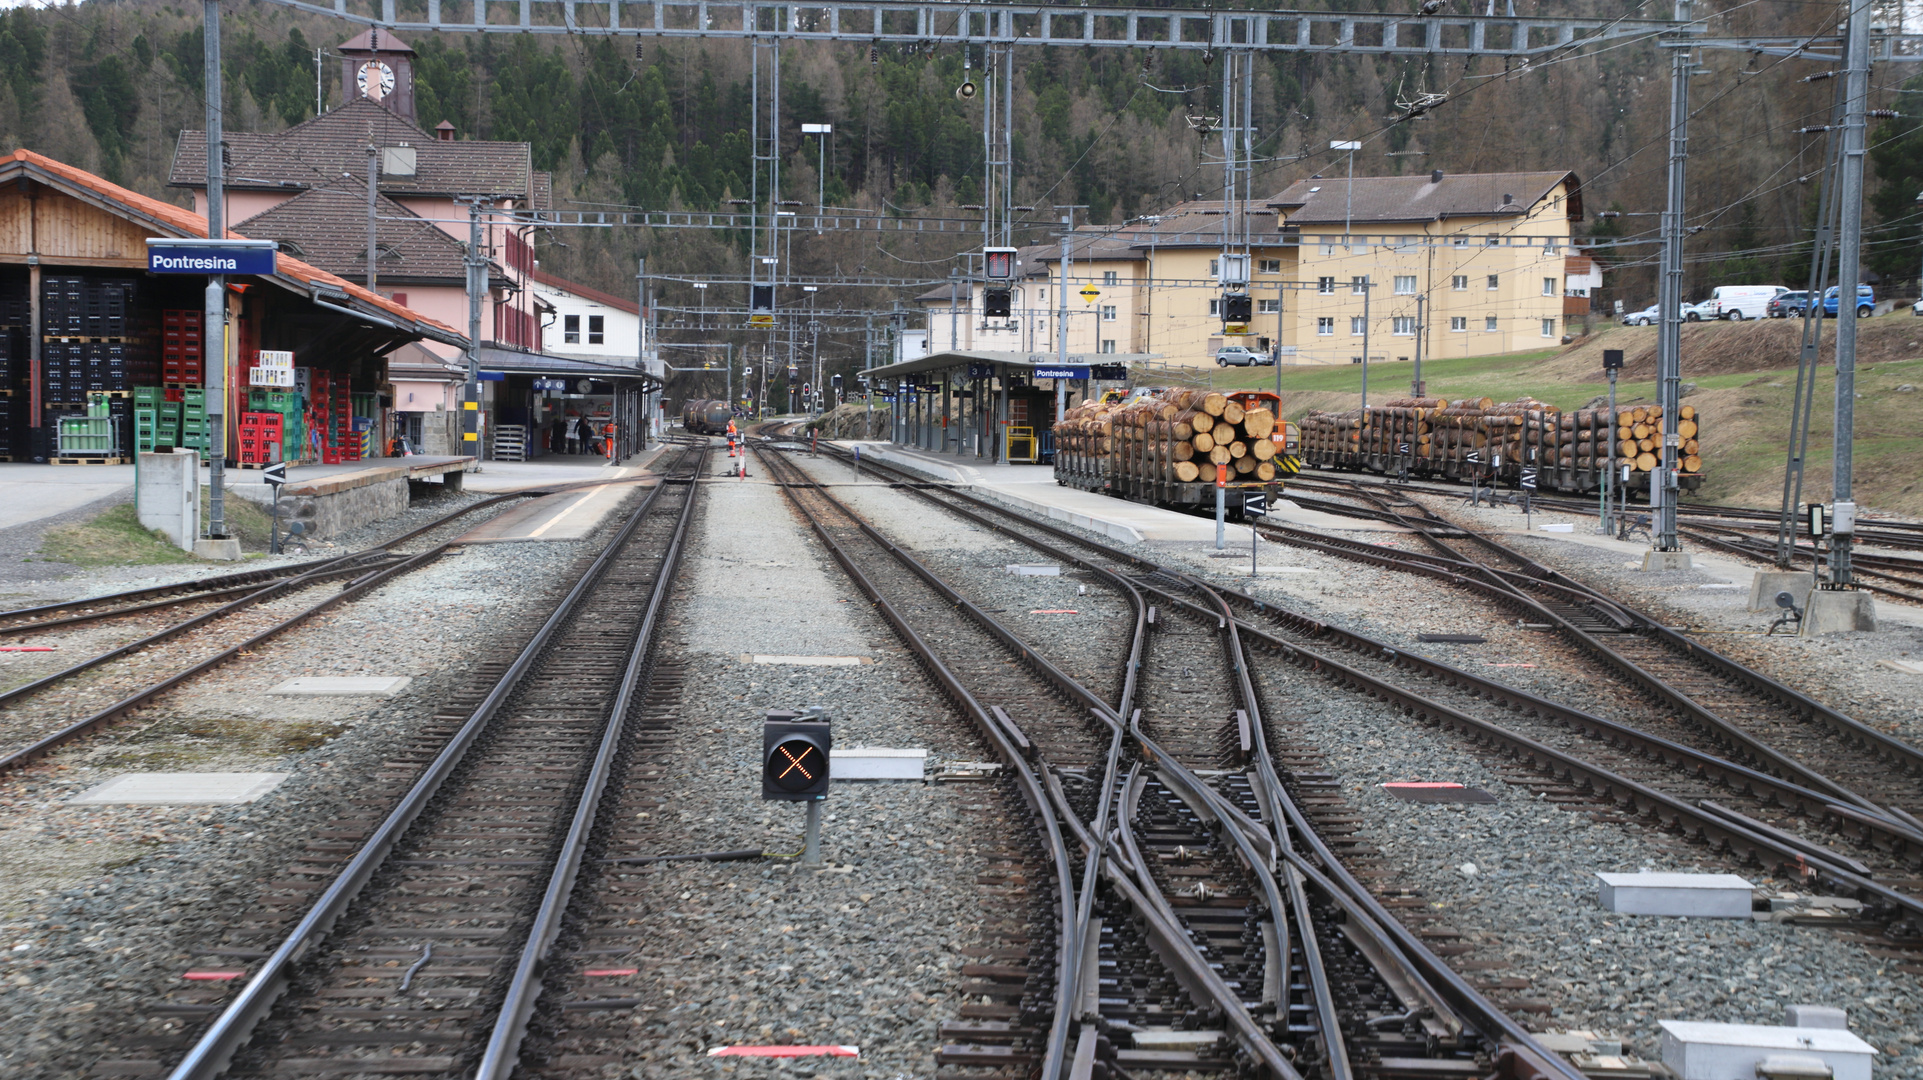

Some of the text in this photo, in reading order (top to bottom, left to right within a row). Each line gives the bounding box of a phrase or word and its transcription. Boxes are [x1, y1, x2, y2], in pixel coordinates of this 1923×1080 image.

[153, 255, 237, 269] Pontresina
[989, 253, 1009, 276] 11
[1272, 434, 1284, 442] 119
